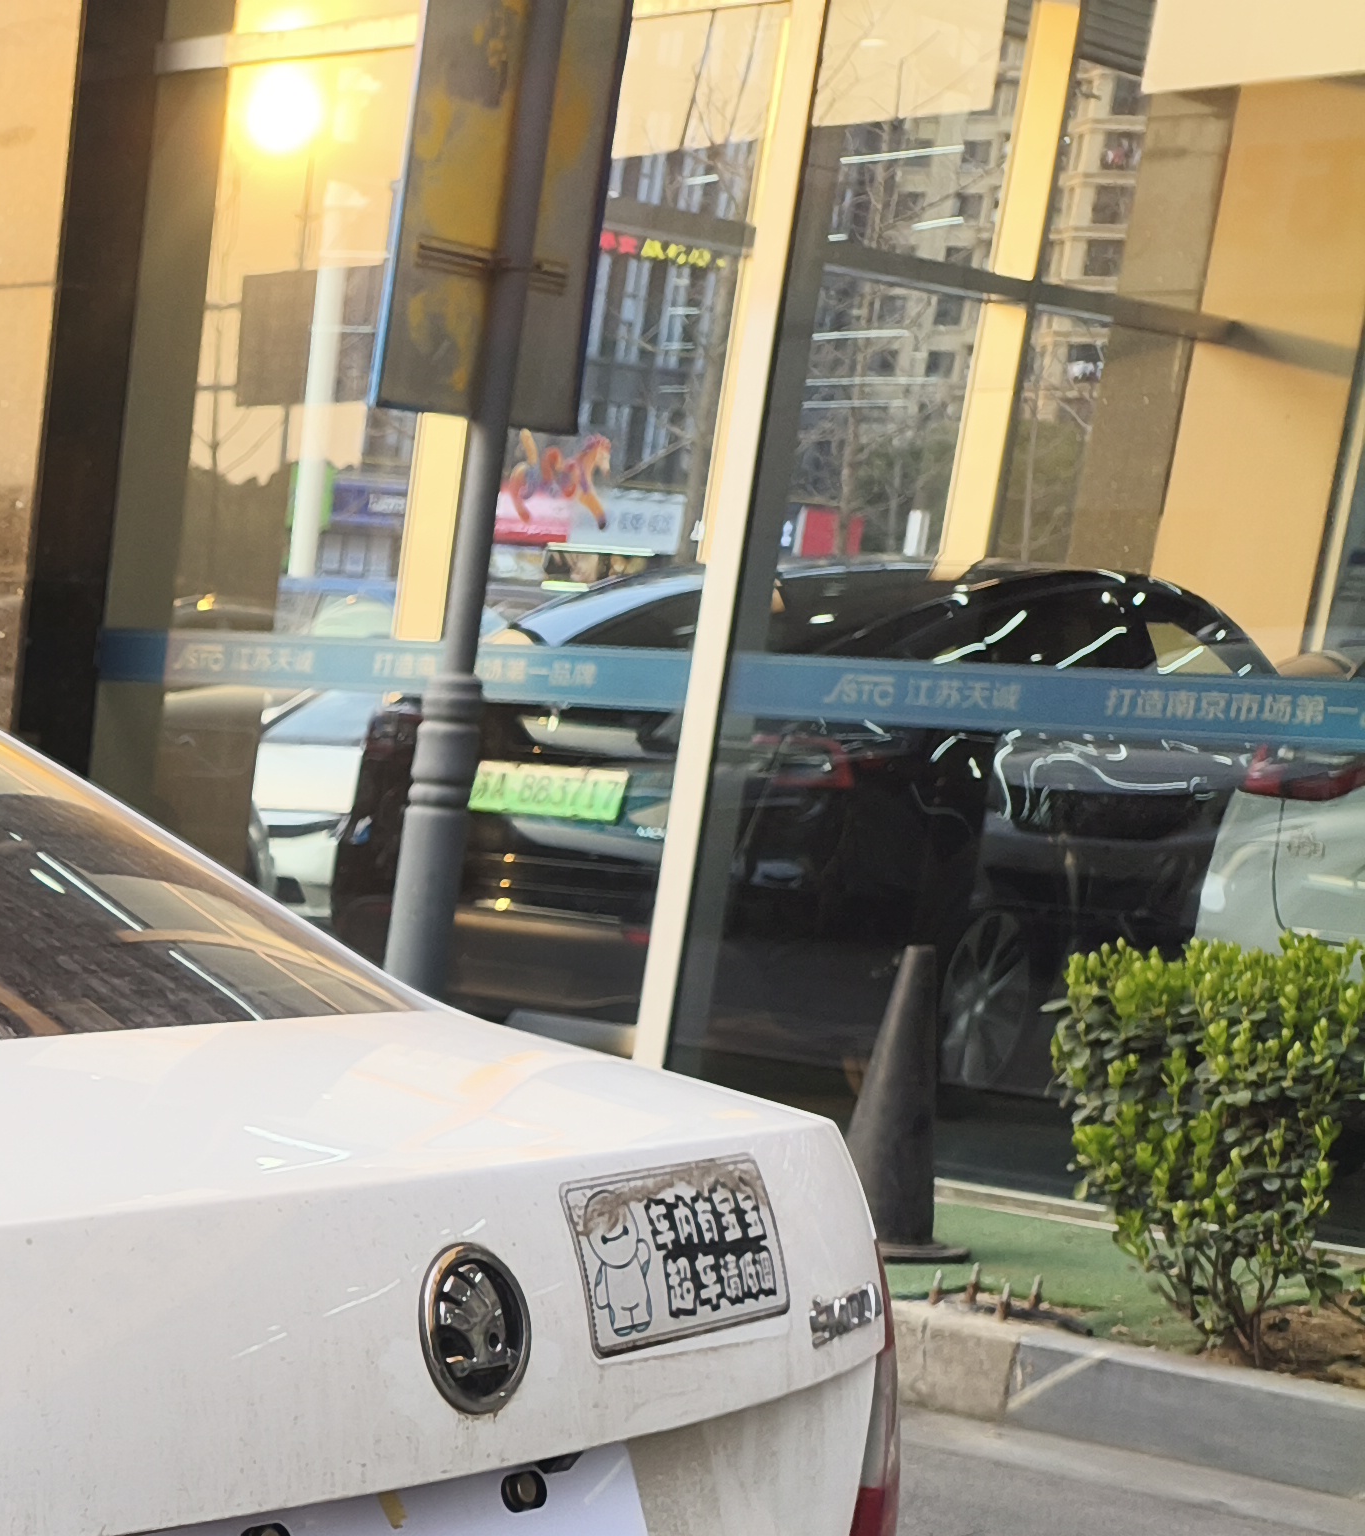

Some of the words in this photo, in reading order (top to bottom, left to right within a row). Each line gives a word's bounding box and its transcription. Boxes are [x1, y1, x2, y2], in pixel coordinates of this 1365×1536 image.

[373, 652, 597, 688] 打造南场第一品牌
[1105, 687, 1365, 729] 打造南京市场第一
[648, 1184, 766, 1250] 车内有宝宝
[666, 1250, 776, 1312] 超车请低调
